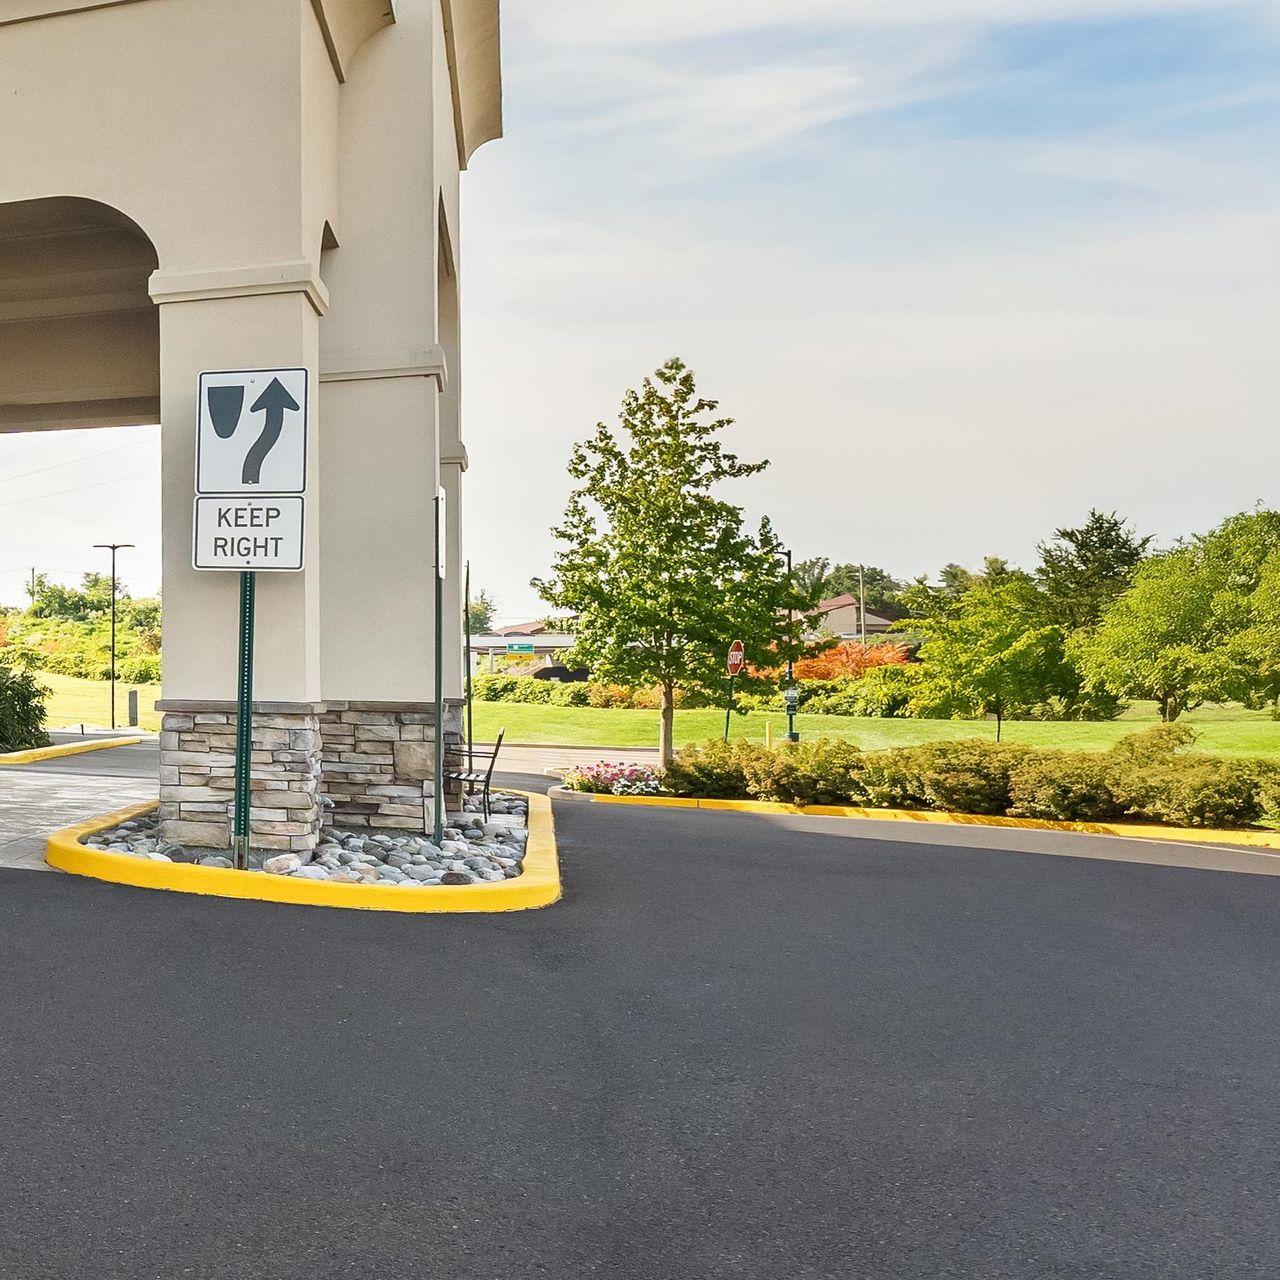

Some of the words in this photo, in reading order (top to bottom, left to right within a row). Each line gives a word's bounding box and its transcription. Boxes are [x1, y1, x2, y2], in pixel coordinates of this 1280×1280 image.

[217, 507, 281, 528] KEEP
[213, 537, 284, 558] RIGHT
[729, 651, 742, 665] STOP
